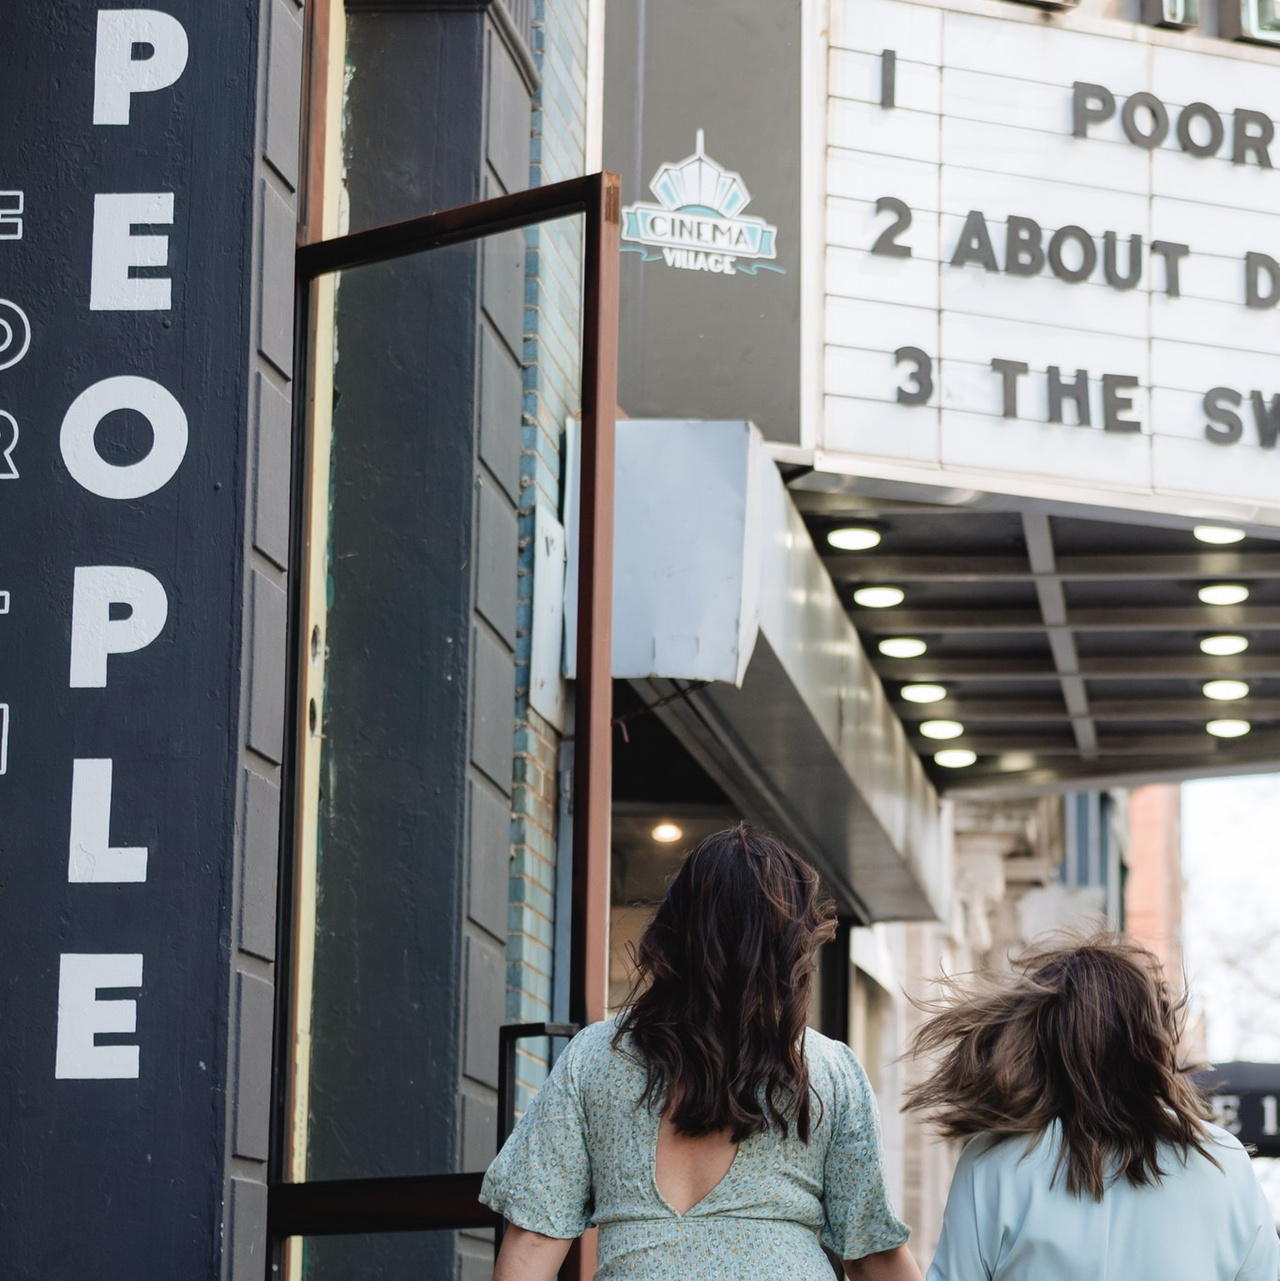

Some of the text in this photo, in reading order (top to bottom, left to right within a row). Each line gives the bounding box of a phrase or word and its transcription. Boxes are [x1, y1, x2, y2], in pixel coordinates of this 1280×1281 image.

[880, 49, 896, 109] 1
[1072, 80, 1275, 169] POOR
[649, 215, 752, 251] CINEMA
[662, 247, 737, 275] VILLAGE
[871, 196, 913, 258] 2
[949, 209, 1190, 298] ABOUT
[893, 345, 934, 406] 3
[990, 357, 1142, 433] THE
[54, 7, 190, 1080] PEOPLE
[1208, 1094, 1242, 1136] E
